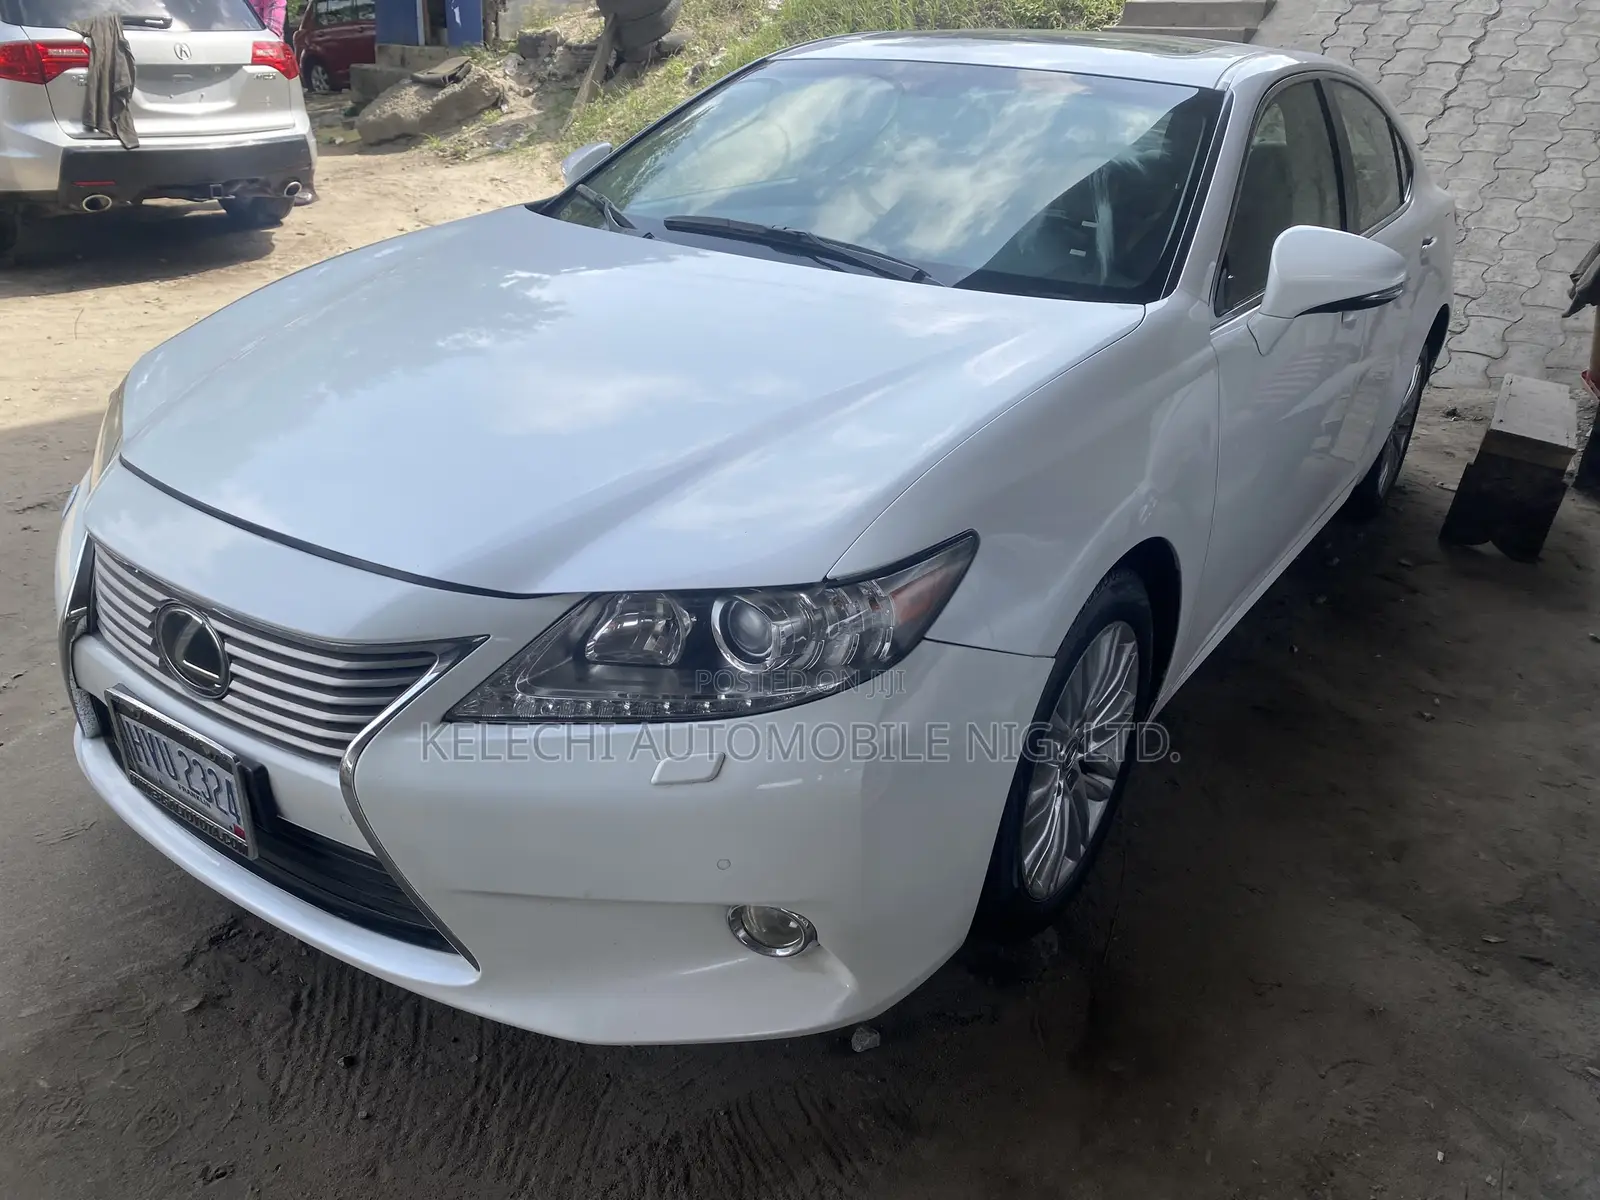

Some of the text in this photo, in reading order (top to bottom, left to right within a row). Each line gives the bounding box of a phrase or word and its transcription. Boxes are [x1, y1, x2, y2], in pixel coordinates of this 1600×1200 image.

[125, 720, 178, 781] HVU
[177, 750, 242, 826] 2324
[177, 783, 212, 809] FRANKLIN
